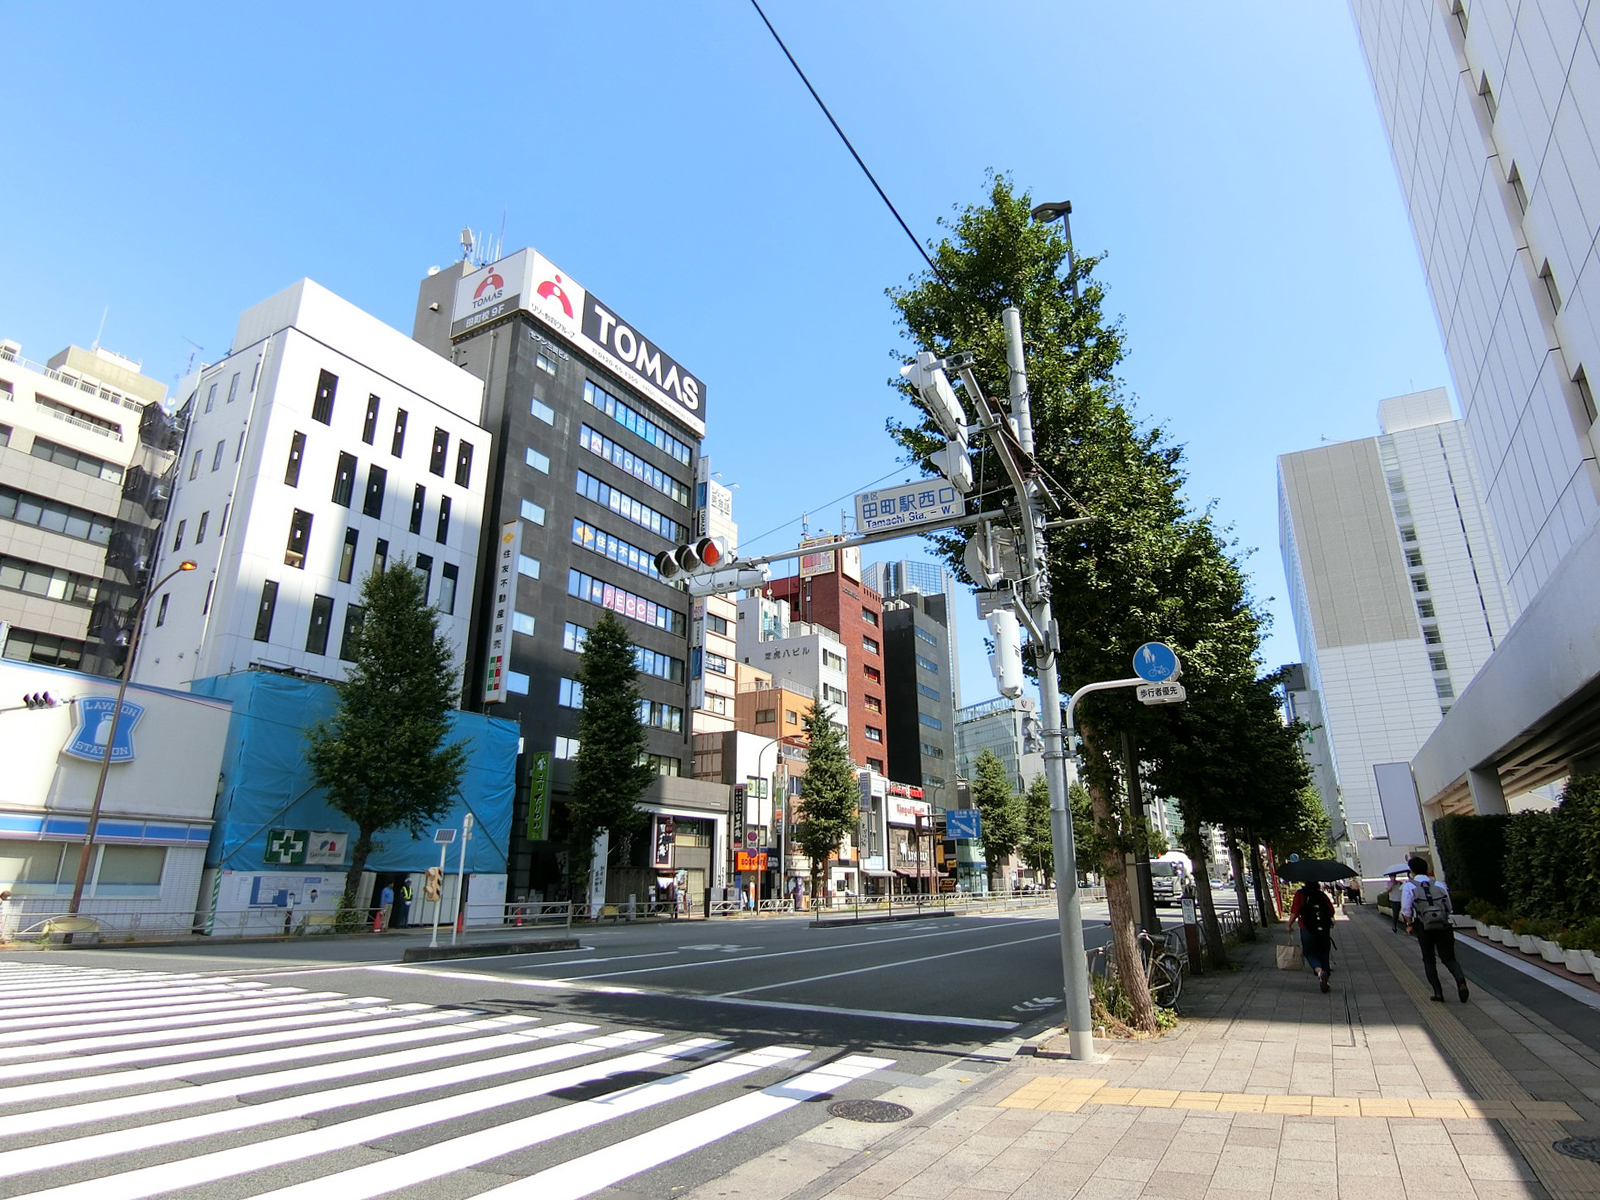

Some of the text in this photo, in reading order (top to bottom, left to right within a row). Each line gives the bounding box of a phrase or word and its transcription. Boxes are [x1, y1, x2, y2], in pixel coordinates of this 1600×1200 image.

[472, 289, 503, 309] TOMAS
[594, 304, 699, 410] TOMAS
[615, 452, 661, 487] TOMAS
[862, 491, 878, 502] 港区
[862, 487, 955, 520] 田町駅西口
[866, 513, 906, 528] Tamachi
[909, 511, 927, 521] Sta.
[941, 505, 955, 515] W.
[493, 549, 511, 649] 住友不動産販売
[616, 594, 646, 615] ECC
[1140, 686, 1178, 698] 歩行者優先
[75, 740, 129, 756] STATON
